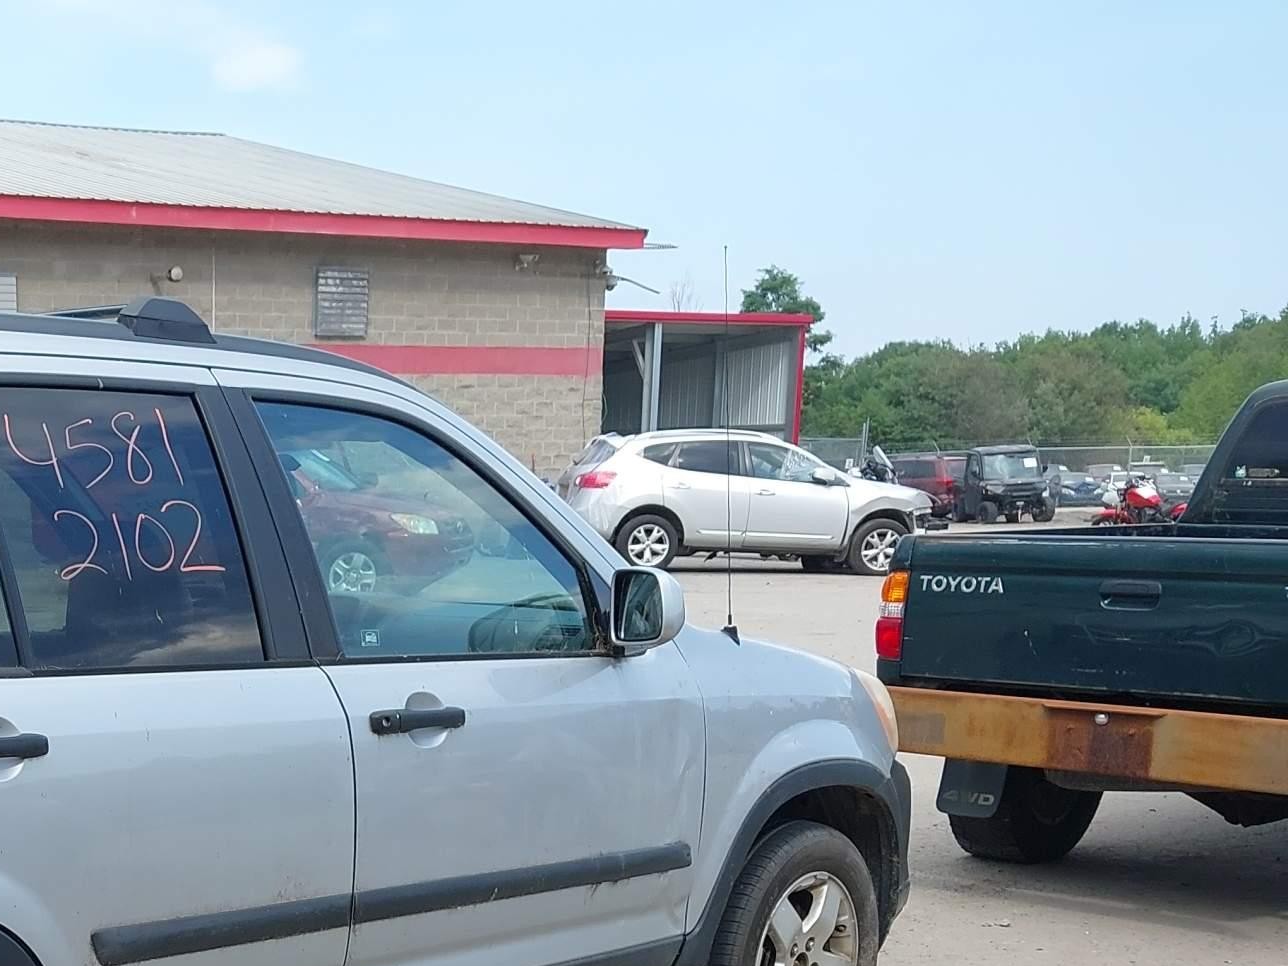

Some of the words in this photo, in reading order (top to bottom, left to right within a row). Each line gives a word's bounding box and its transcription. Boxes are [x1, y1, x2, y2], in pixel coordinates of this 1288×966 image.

[3, 407, 185, 489] 4581
[53, 499, 226, 581] 2102
[919, 574, 1004, 594] TOYOTA
